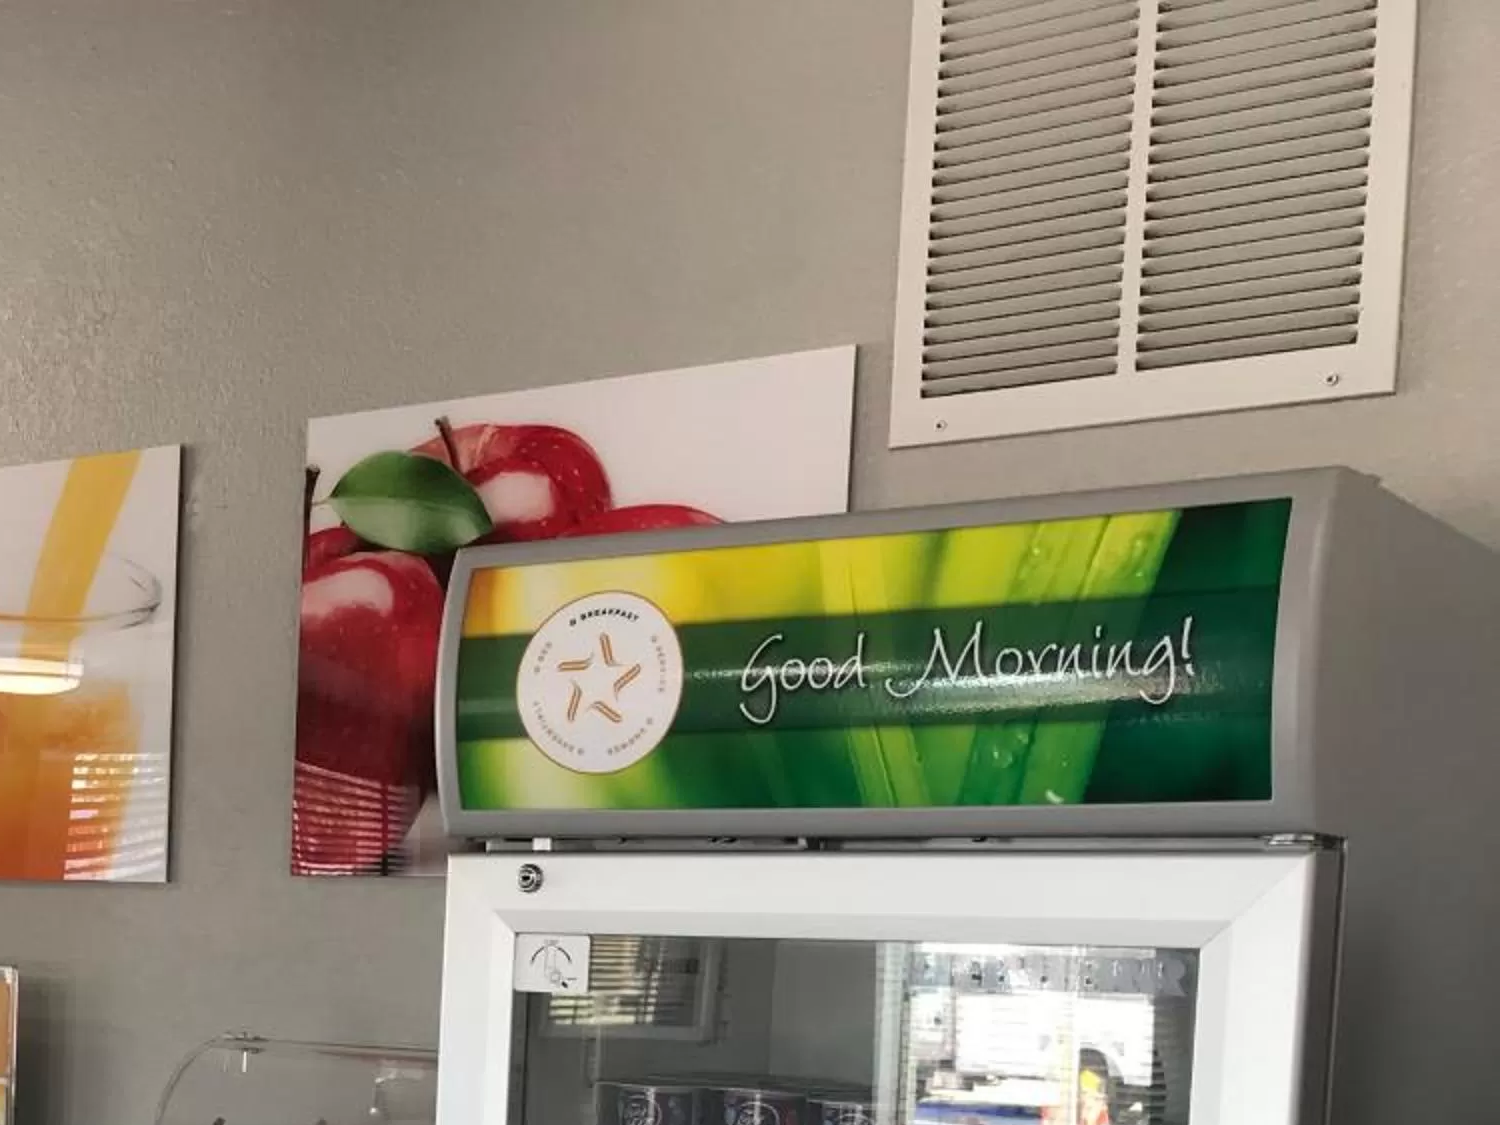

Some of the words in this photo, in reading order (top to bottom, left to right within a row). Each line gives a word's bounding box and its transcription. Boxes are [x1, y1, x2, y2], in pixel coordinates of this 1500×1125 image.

[580, 608, 640, 621] BREAKFAST
[740, 633, 866, 724] Good
[885, 615, 1196, 704] Morning!
